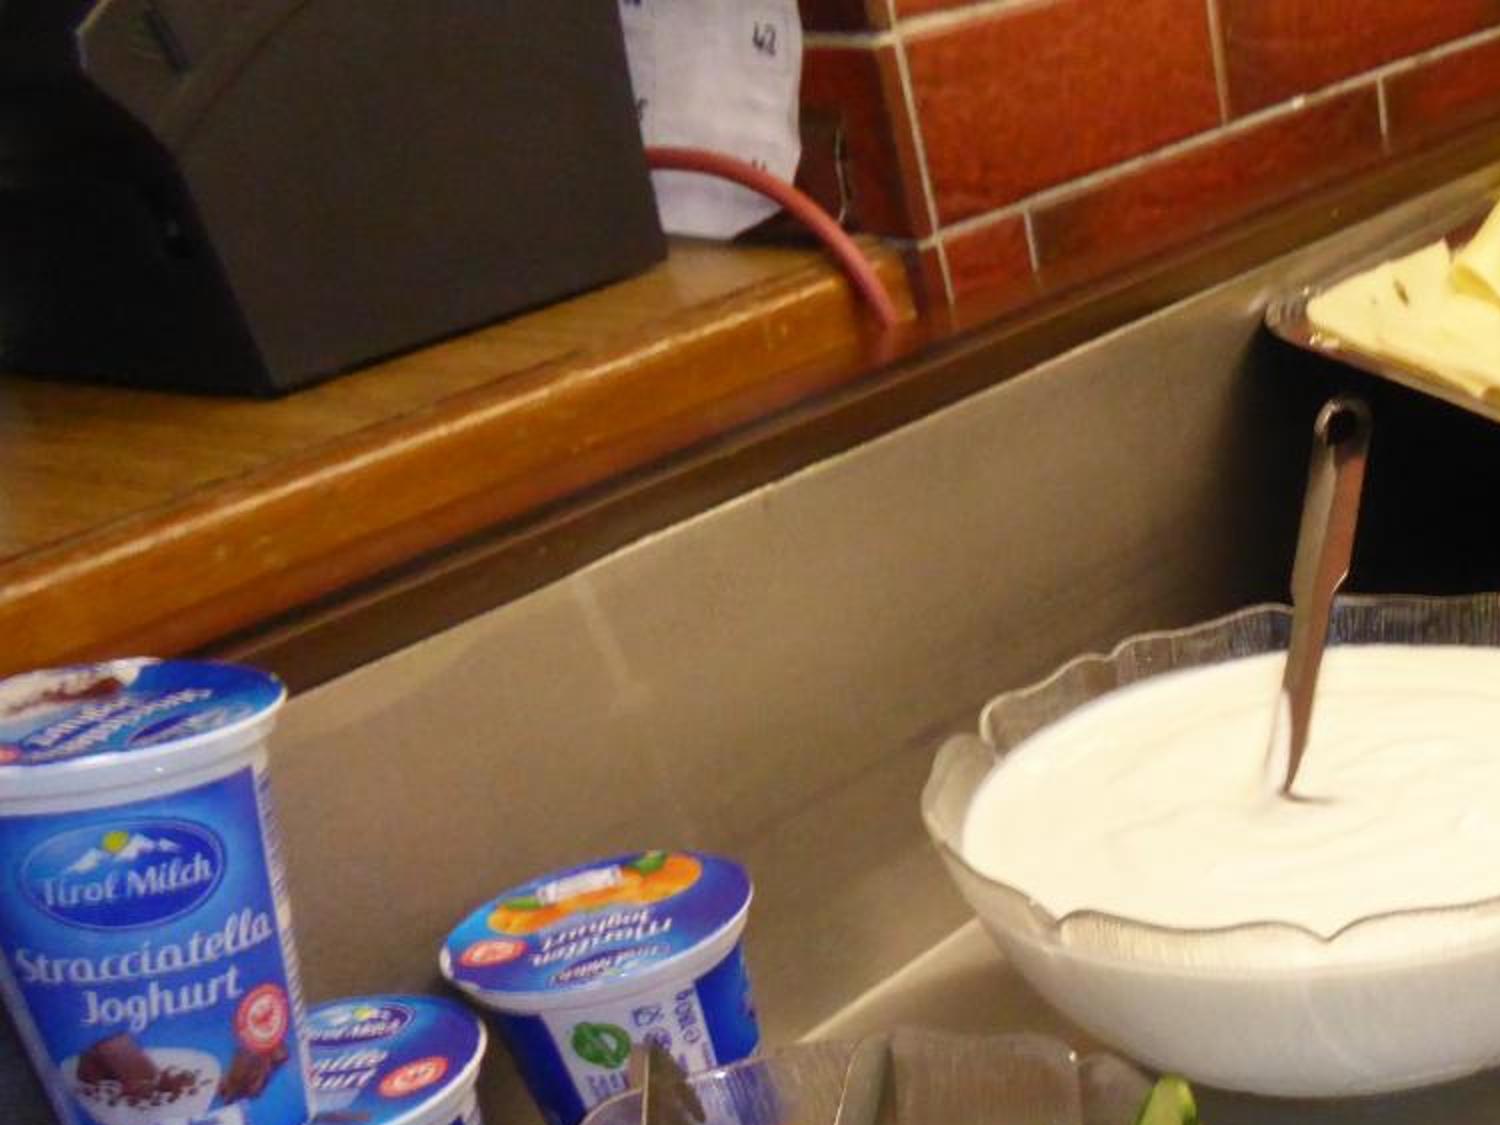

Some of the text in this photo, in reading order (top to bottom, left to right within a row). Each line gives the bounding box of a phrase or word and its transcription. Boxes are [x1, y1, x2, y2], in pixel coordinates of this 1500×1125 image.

[38, 850, 213, 906] Tirol Milch
[14, 907, 273, 984] Stracciatella
[80, 964, 243, 1033] Joghurt
